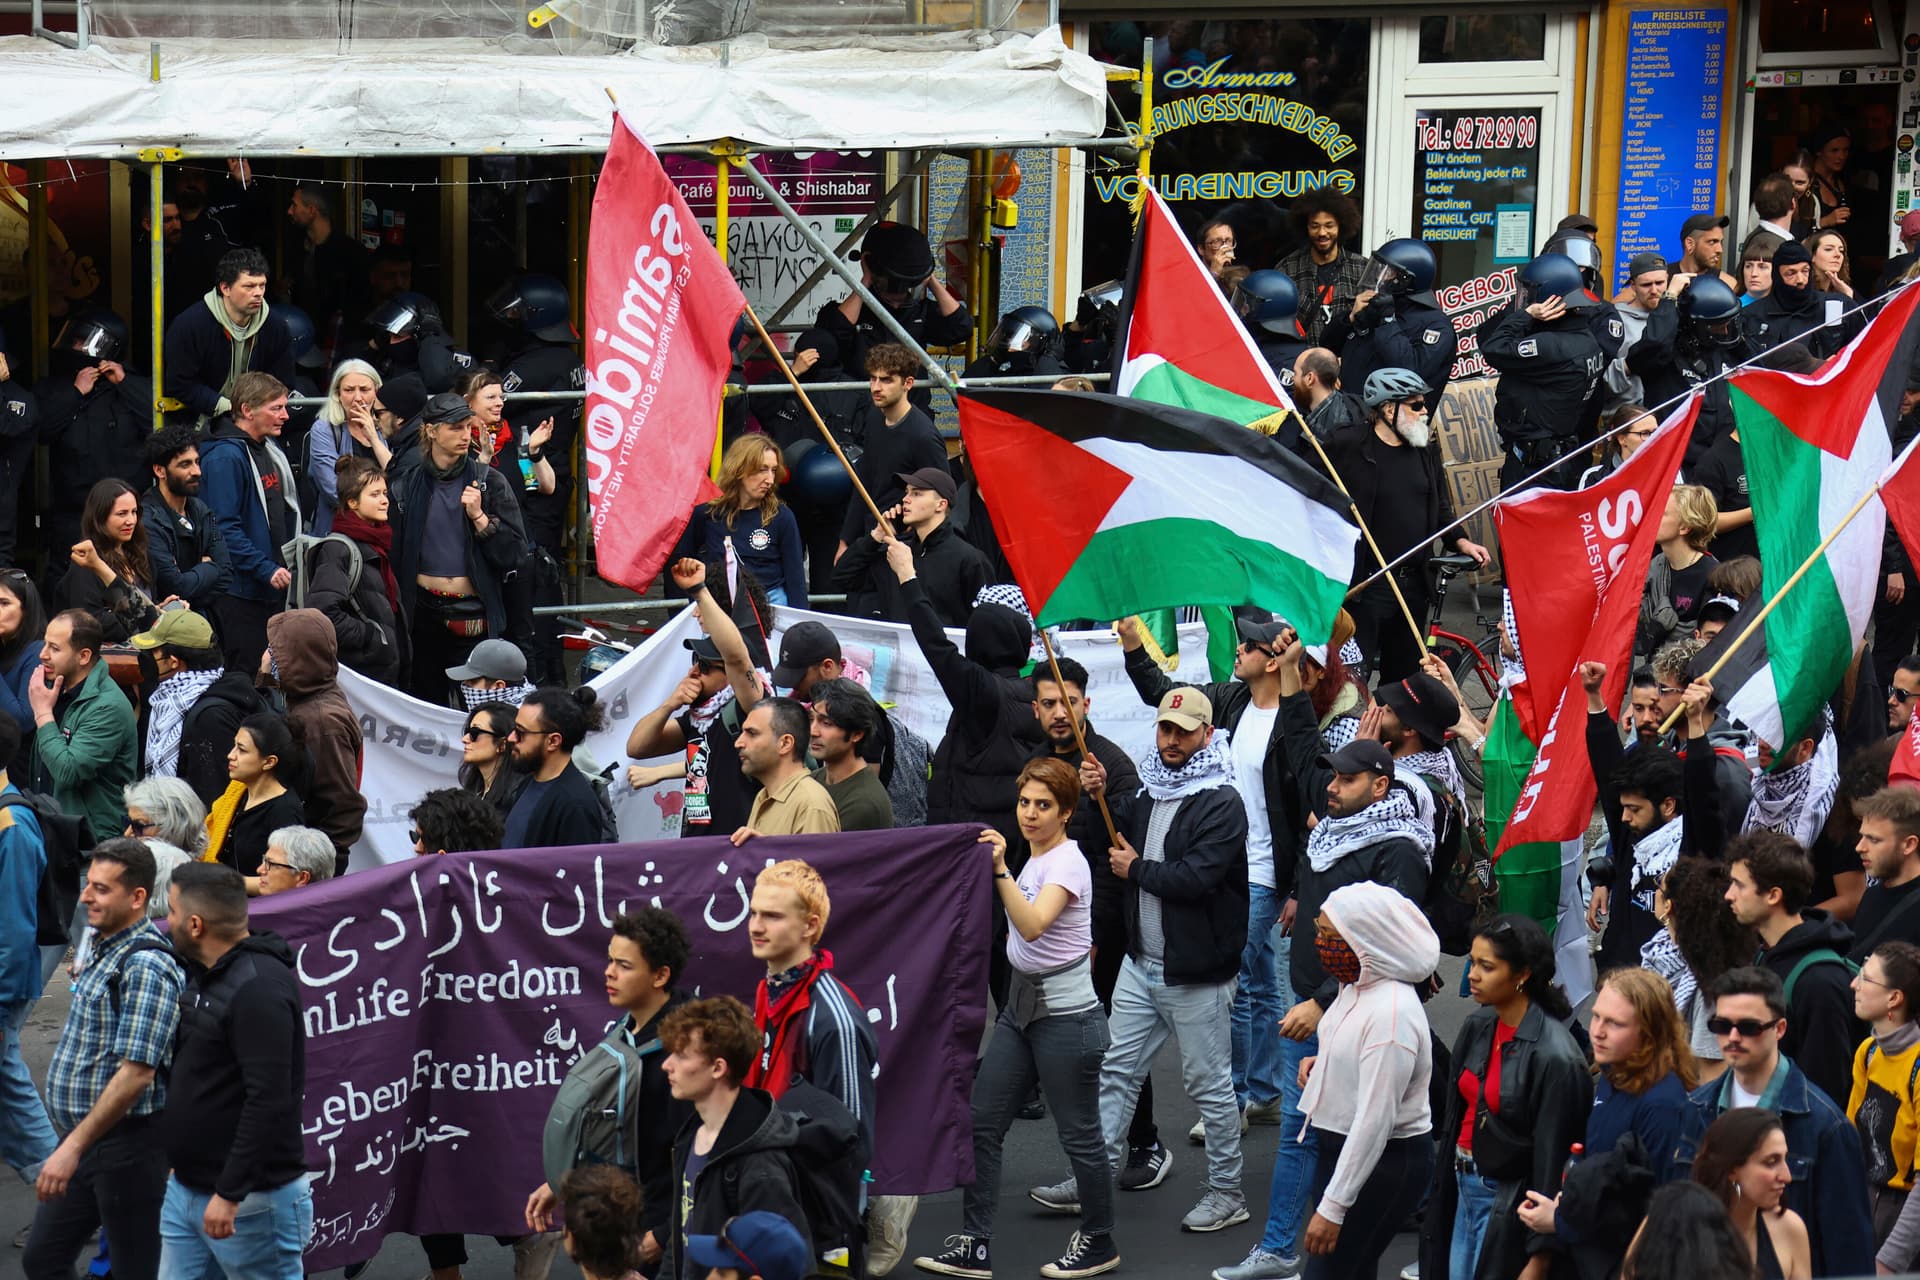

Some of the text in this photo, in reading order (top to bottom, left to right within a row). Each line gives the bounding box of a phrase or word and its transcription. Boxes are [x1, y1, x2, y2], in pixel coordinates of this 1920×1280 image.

[1652, 11, 1706, 20] PREISLISTE
[1632, 20, 1725, 30] ÄNDERUNGSSCHNEIDEREI
[1163, 55, 1296, 89] Arman
[1098, 93, 1360, 171] RUNGSSCHNEIDEREI
[1454, 117, 1474, 149] 62
[1475, 117, 1495, 149] 72
[1495, 116, 1516, 148] 29
[1517, 115, 1537, 148] 90
[1426, 152, 1481, 164] Wir ändern
[1425, 166, 1527, 181] Bekleidung jeder Art
[679, 180, 871, 200] Café oung & Shishabar
[1425, 182, 1454, 194] Leder
[1424, 198, 1472, 210] Gardinen
[1422, 212, 1495, 226] SCHNELL, GUT,
[1422, 228, 1478, 241] PREISWERT
[1436, 266, 1518, 310] GEBOT
[1169, 695, 1183, 708] B
[418, 959, 582, 1010] Freedom
[410, 1050, 562, 1093] Freiheit
